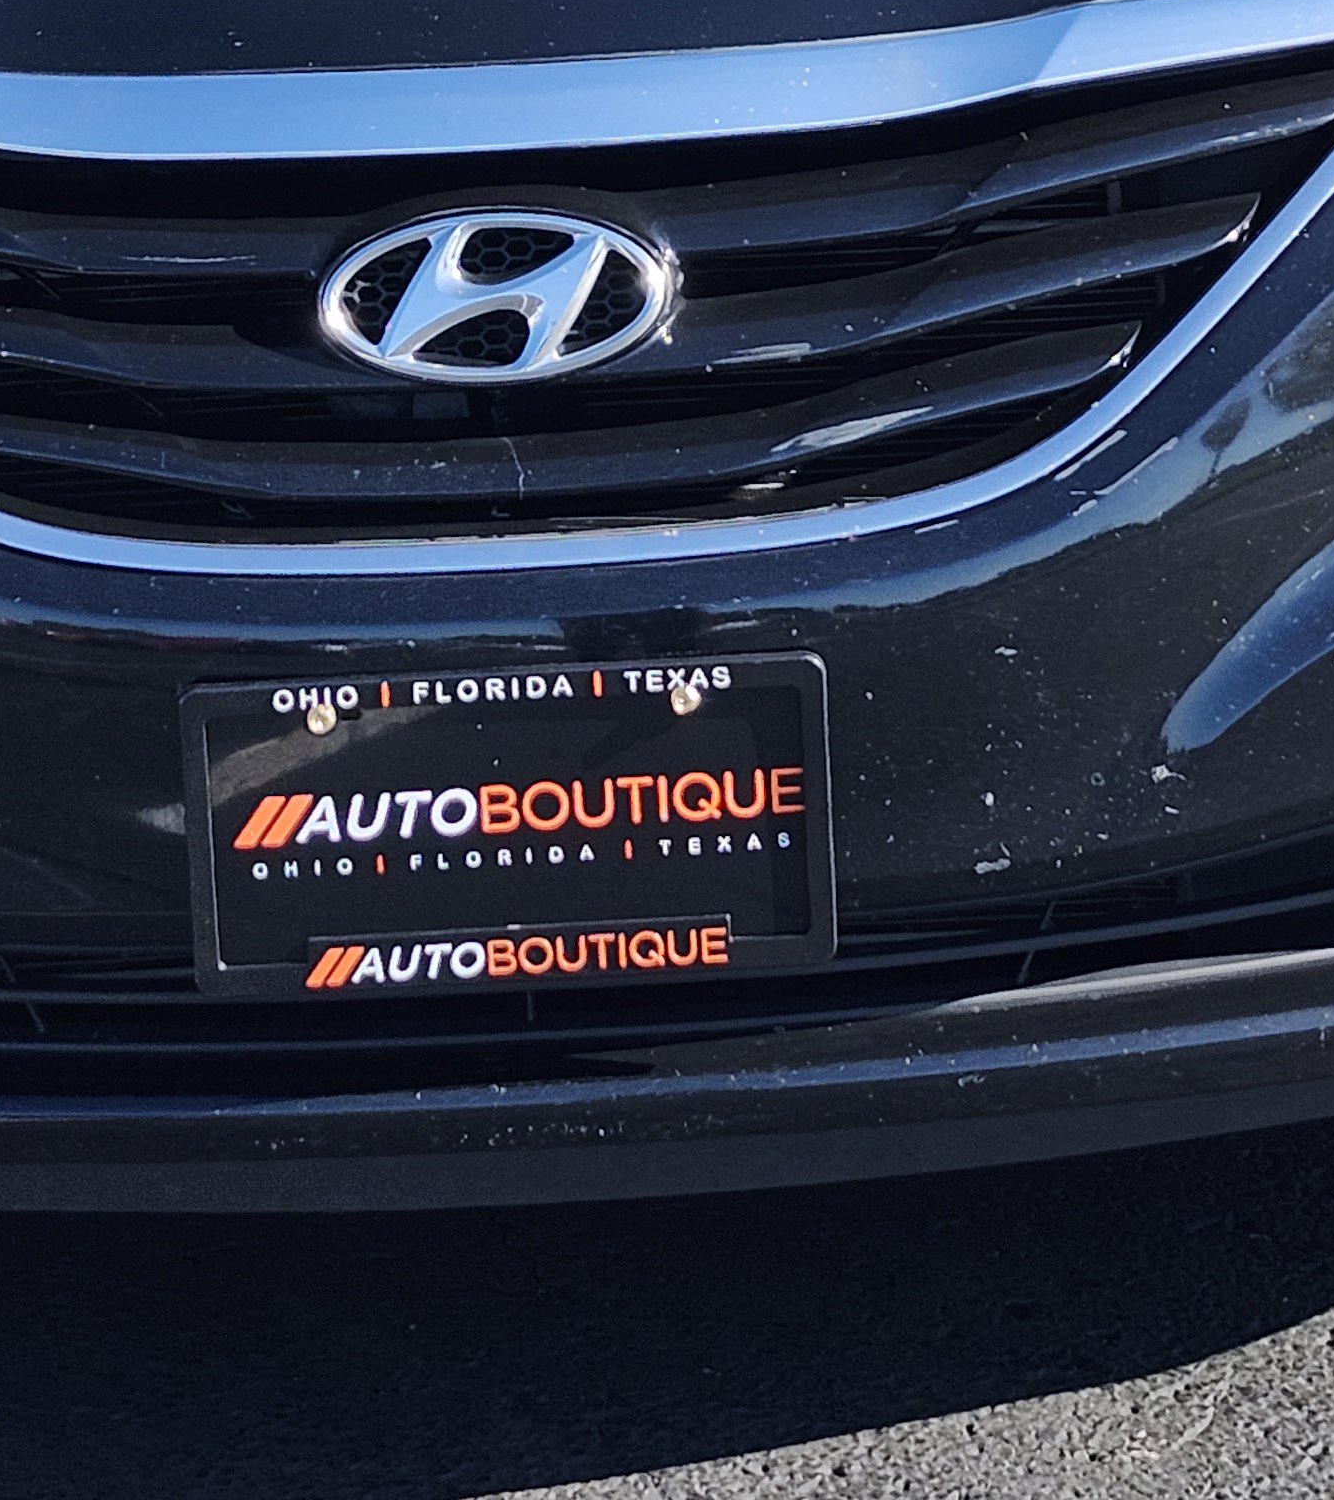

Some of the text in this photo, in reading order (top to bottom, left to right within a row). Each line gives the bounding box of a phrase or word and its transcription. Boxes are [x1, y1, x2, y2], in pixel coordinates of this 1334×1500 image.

[272, 665, 732, 714] OHIO FLORIDA TEXAS
[295, 766, 806, 844] AUTOBOUTIQUE
[251, 831, 792, 881] OHIO FLORIDA TEXAS
[350, 926, 731, 984] AUTOBOUTIQUE
